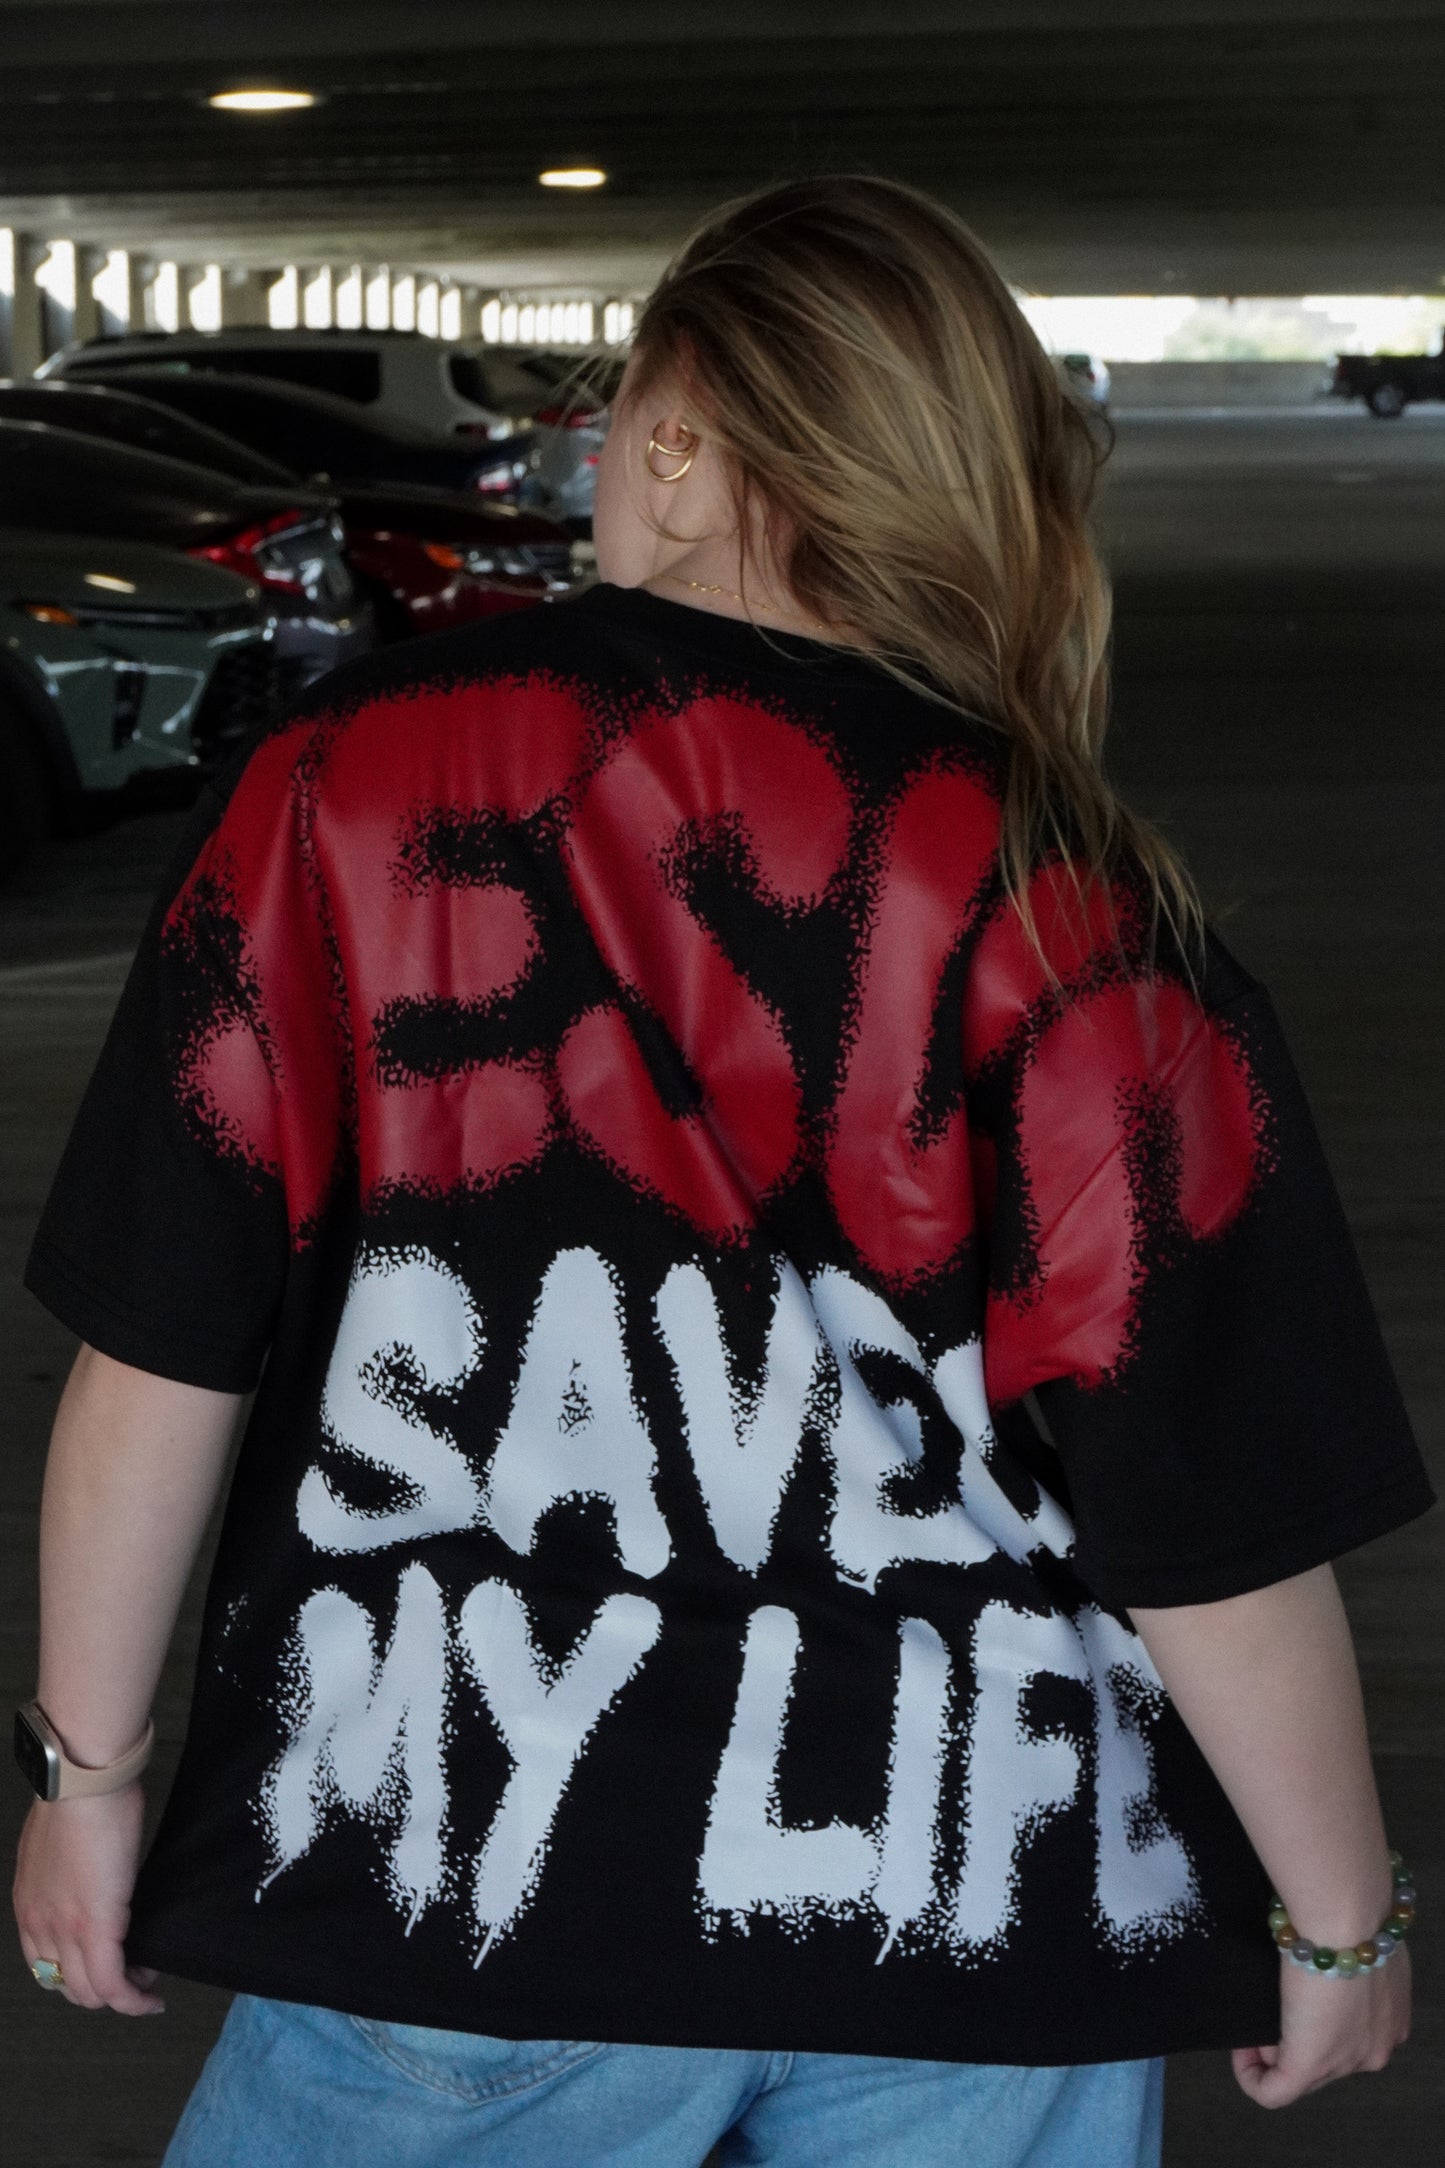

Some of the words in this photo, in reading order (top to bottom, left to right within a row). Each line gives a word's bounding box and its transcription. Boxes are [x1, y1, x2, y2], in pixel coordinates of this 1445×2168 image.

[164, 668, 1274, 1403] JESUS
[254, 1560, 662, 1970] MY
[694, 1599, 1206, 1970] LIFE
